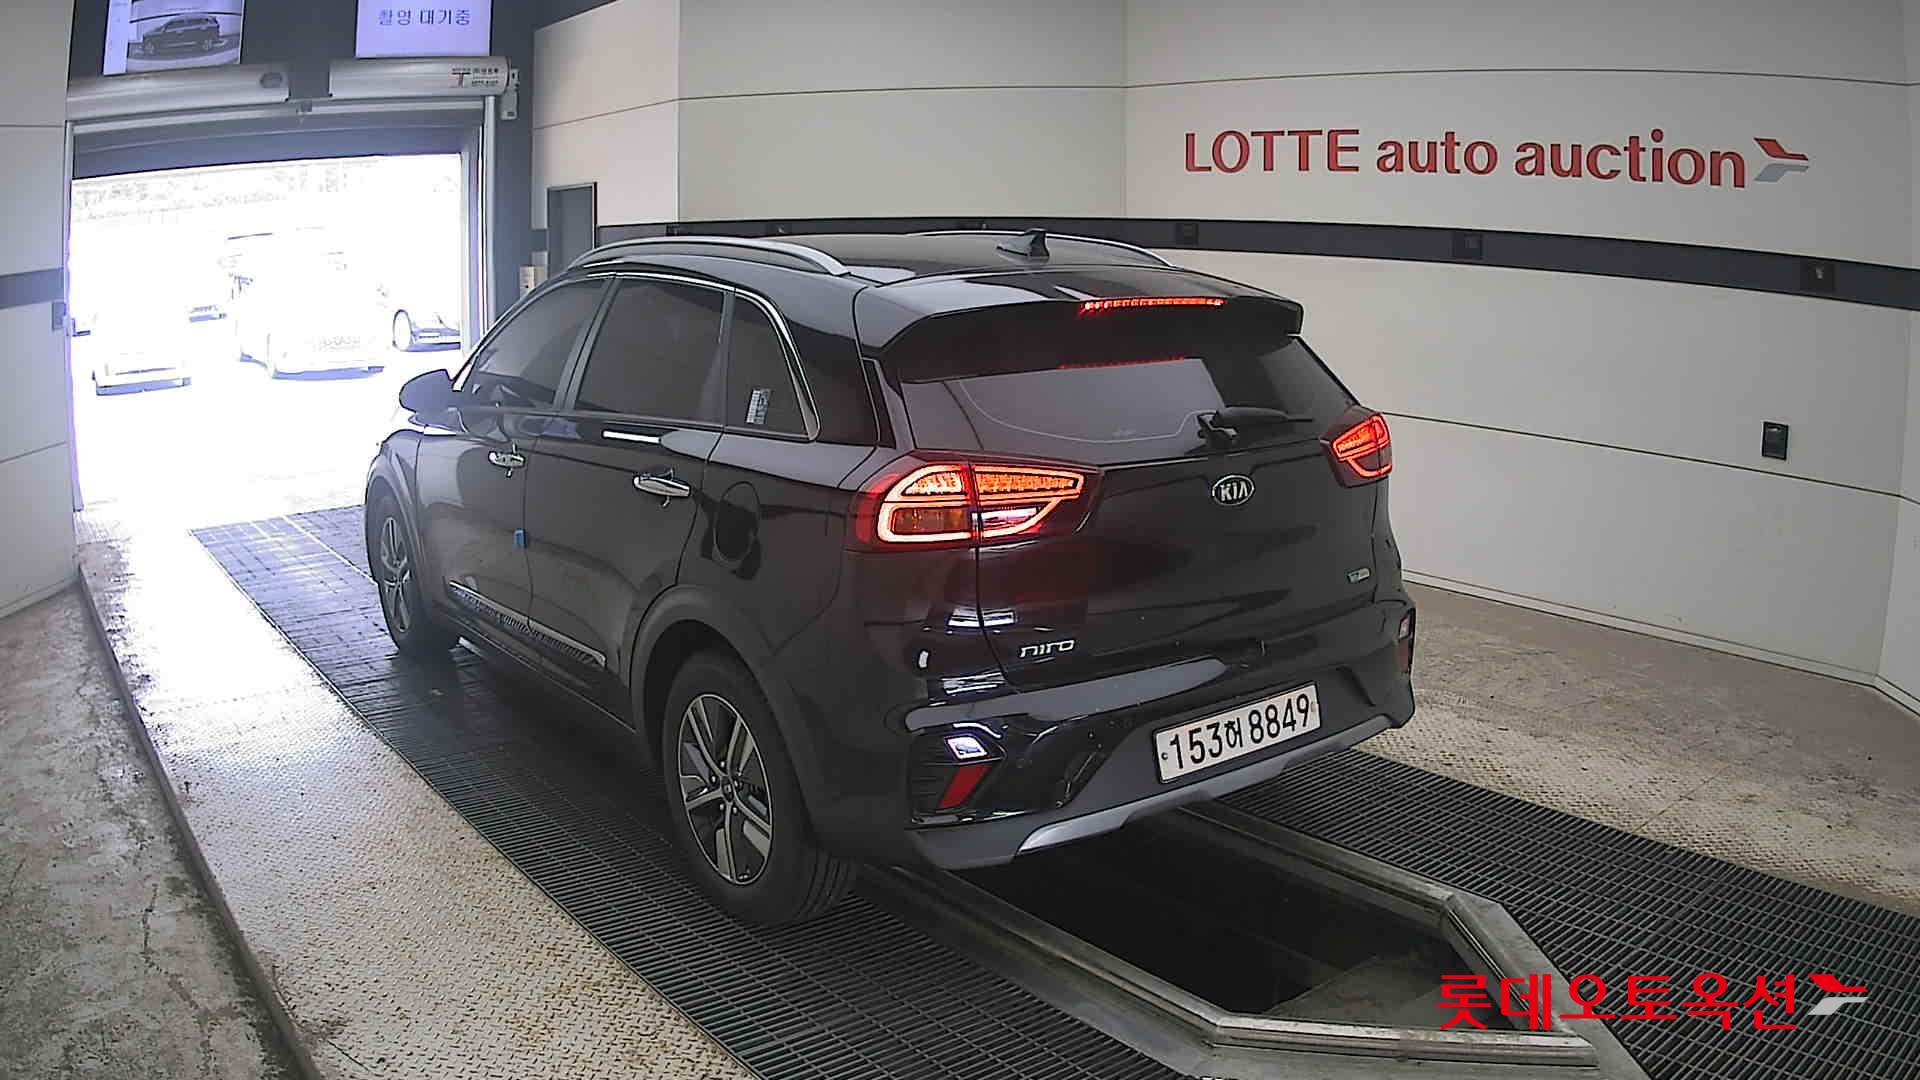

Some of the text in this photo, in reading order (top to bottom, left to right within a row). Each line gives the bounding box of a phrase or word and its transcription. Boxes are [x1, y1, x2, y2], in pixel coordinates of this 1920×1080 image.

[420, 9, 471, 26] 대기중
[1185, 128, 1745, 189] LOTTE auto auction
[1220, 480, 1248, 501] KIA
